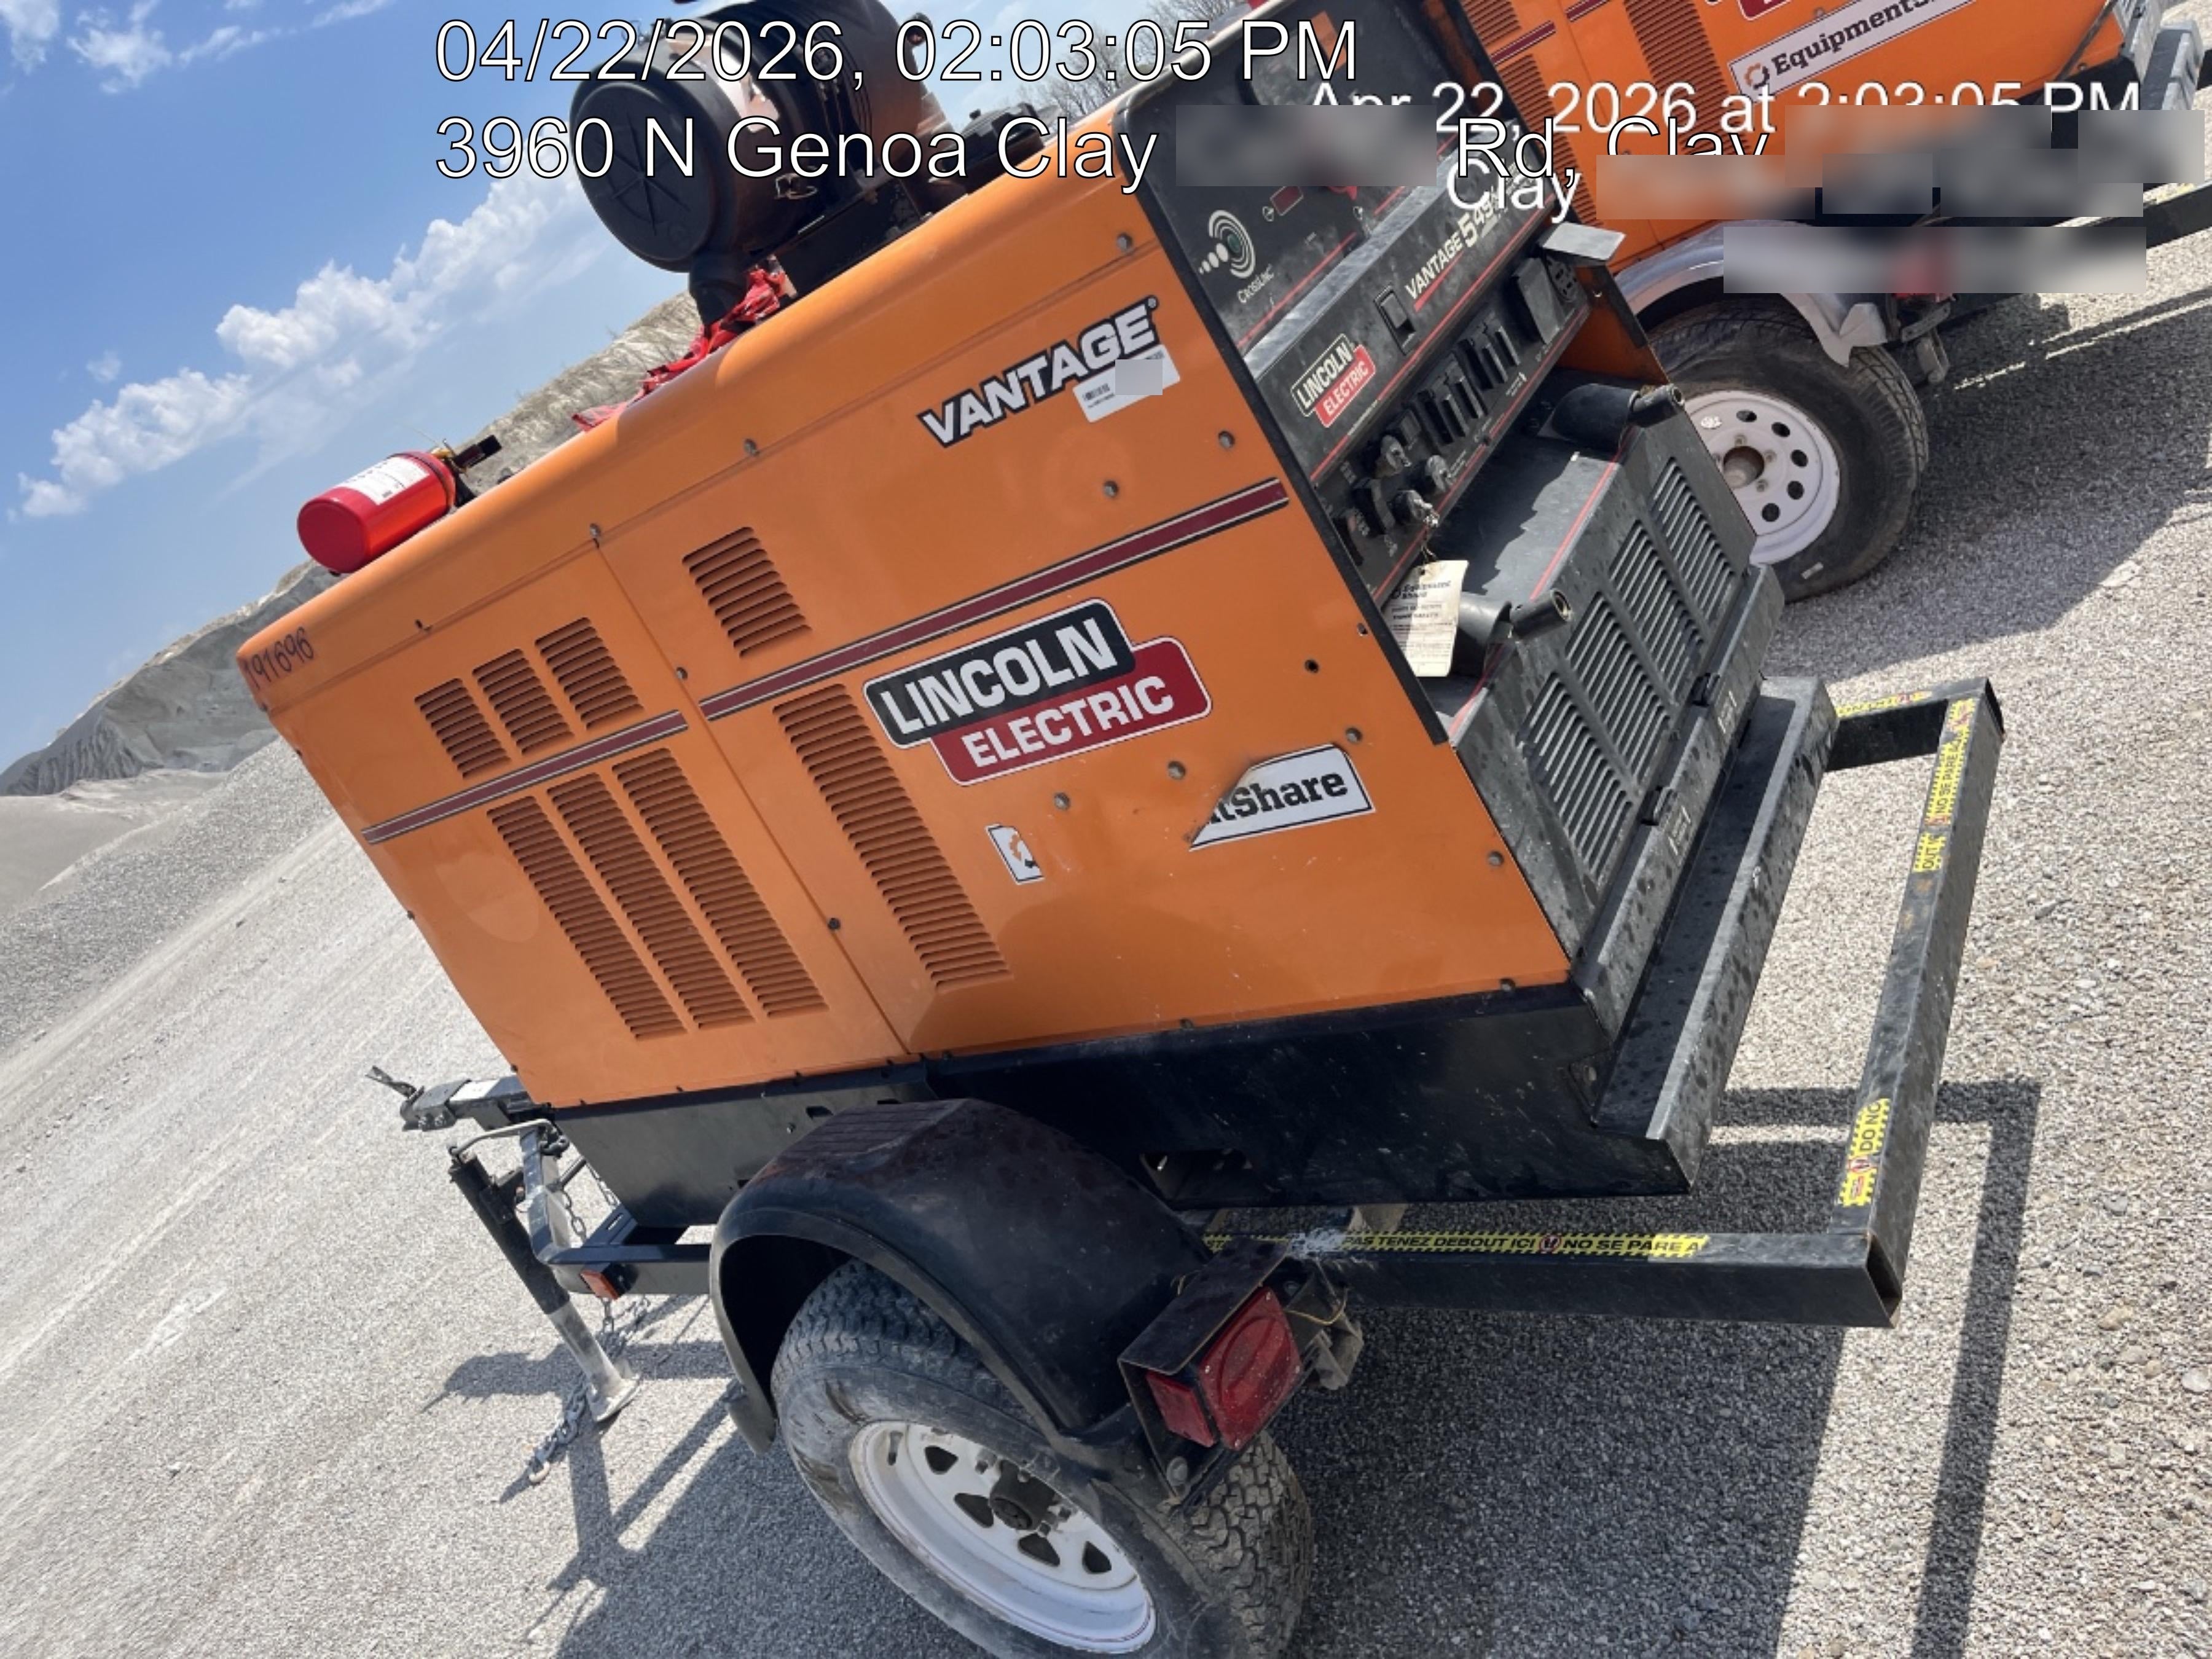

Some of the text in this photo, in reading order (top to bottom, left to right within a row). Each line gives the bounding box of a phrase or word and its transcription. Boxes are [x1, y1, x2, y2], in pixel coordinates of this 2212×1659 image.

[1405, 231, 1464, 299] VANTAGE
[922, 301, 1158, 445] VANTAGE
[1296, 342, 1354, 408] LINCOLN
[1322, 361, 1370, 416] ELECTRIC
[882, 618, 1118, 735] LINCOLN
[962, 676, 1174, 767] ELECTRIC
[1209, 772, 1348, 825] tShare
[1859, 1129, 1876, 1152] DO
[1377, 1237, 1429, 1246] TENEZ
[1432, 1237, 1508, 1247] DEBOUT
[1510, 1237, 1535, 1248] ICI
[1563, 1238, 1592, 1249] NO
[1596, 1239, 1623, 1250] SE
[1628, 1240, 1684, 1251] PARE
